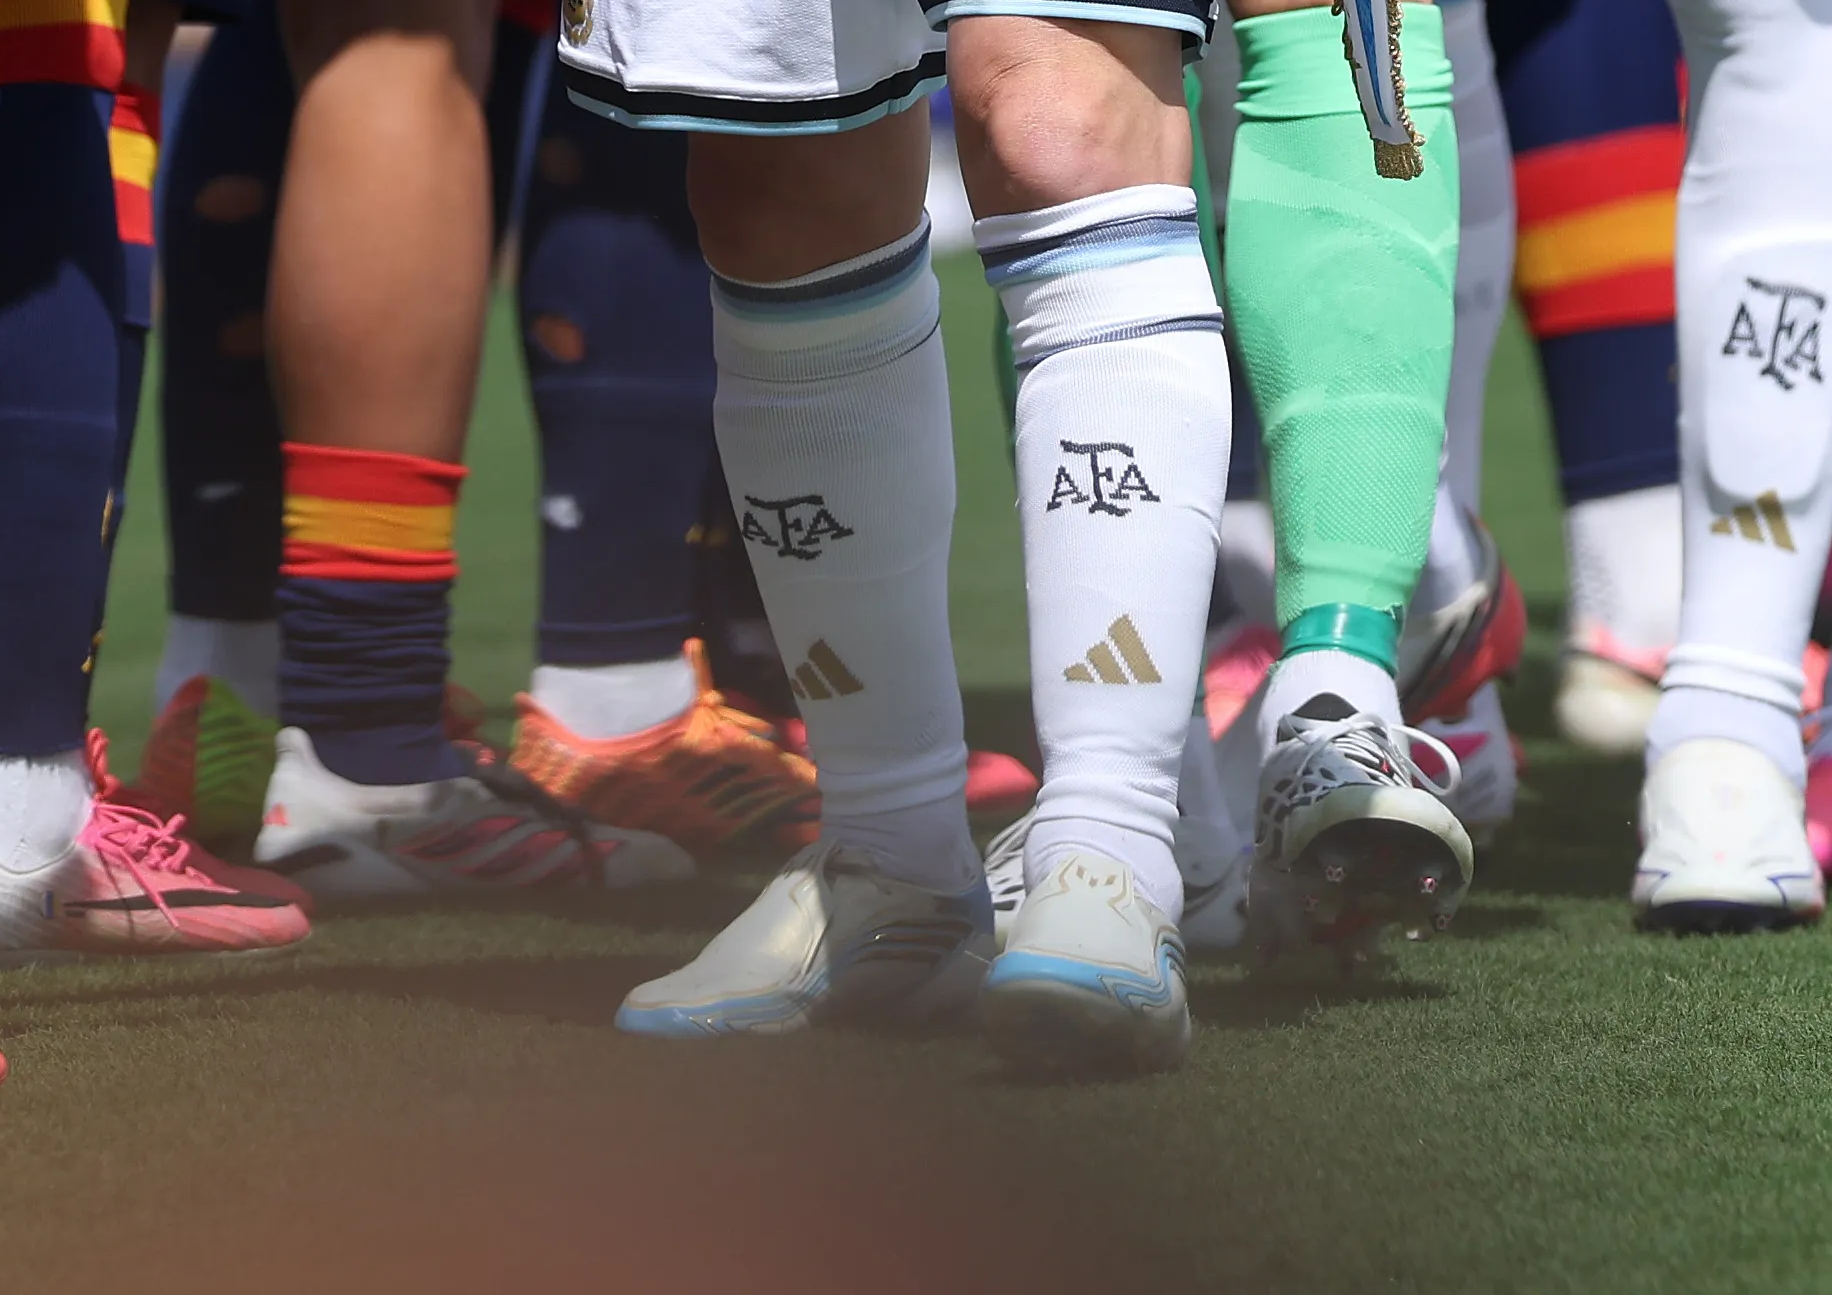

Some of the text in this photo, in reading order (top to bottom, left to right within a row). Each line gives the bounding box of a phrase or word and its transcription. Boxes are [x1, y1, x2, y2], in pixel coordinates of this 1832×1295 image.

[1722, 276, 1826, 391] AFA
[1047, 439, 1160, 516] AFA
[742, 495, 855, 560] AFA
